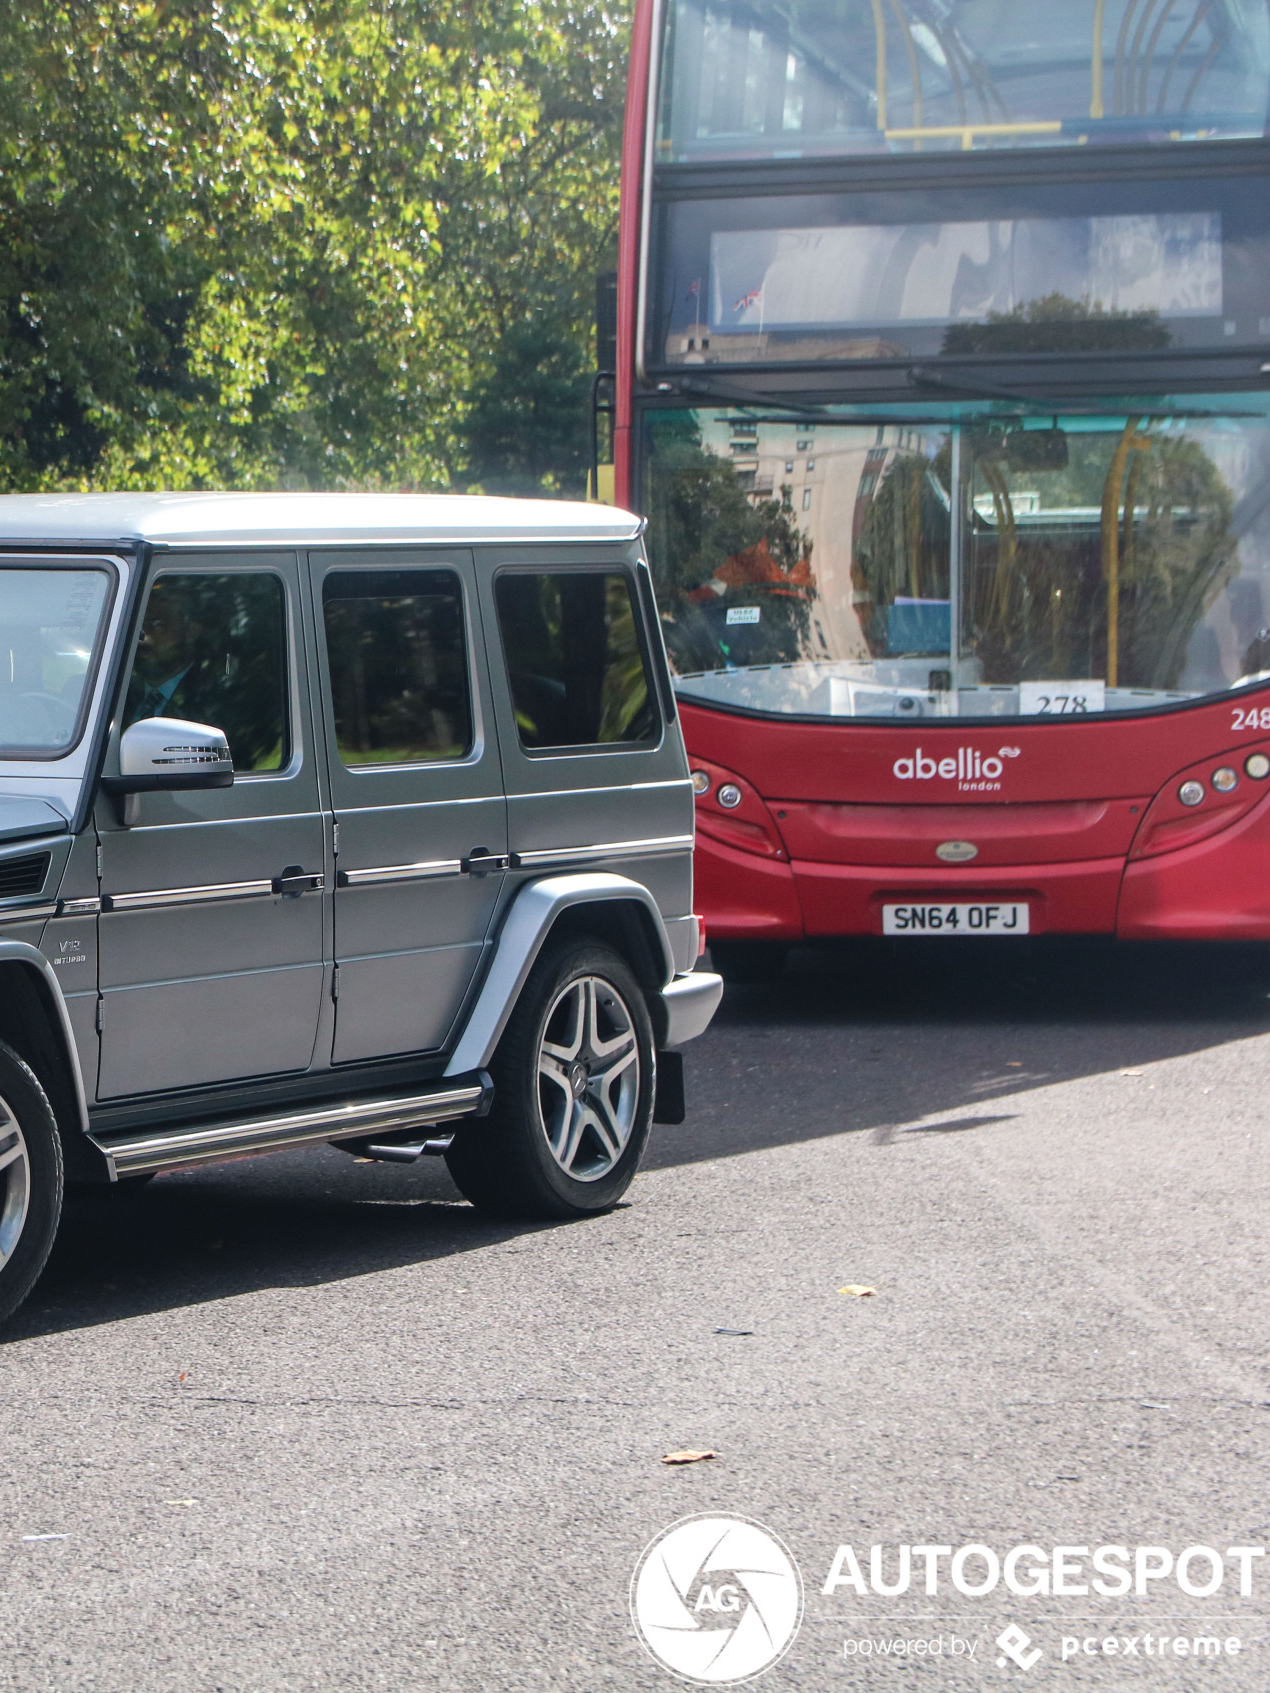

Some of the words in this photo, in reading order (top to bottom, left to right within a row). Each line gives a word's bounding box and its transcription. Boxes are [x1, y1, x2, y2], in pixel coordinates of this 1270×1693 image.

[1037, 696, 1088, 714] 278
[1230, 707, 1270, 731] 248
[893, 747, 1003, 780] abellio
[958, 781, 1001, 791] london
[894, 906, 959, 929] SN64
[968, 906, 1018, 929] OFJ
[58, 940, 81, 953] V12
[54, 954, 86, 965] BITURBO
